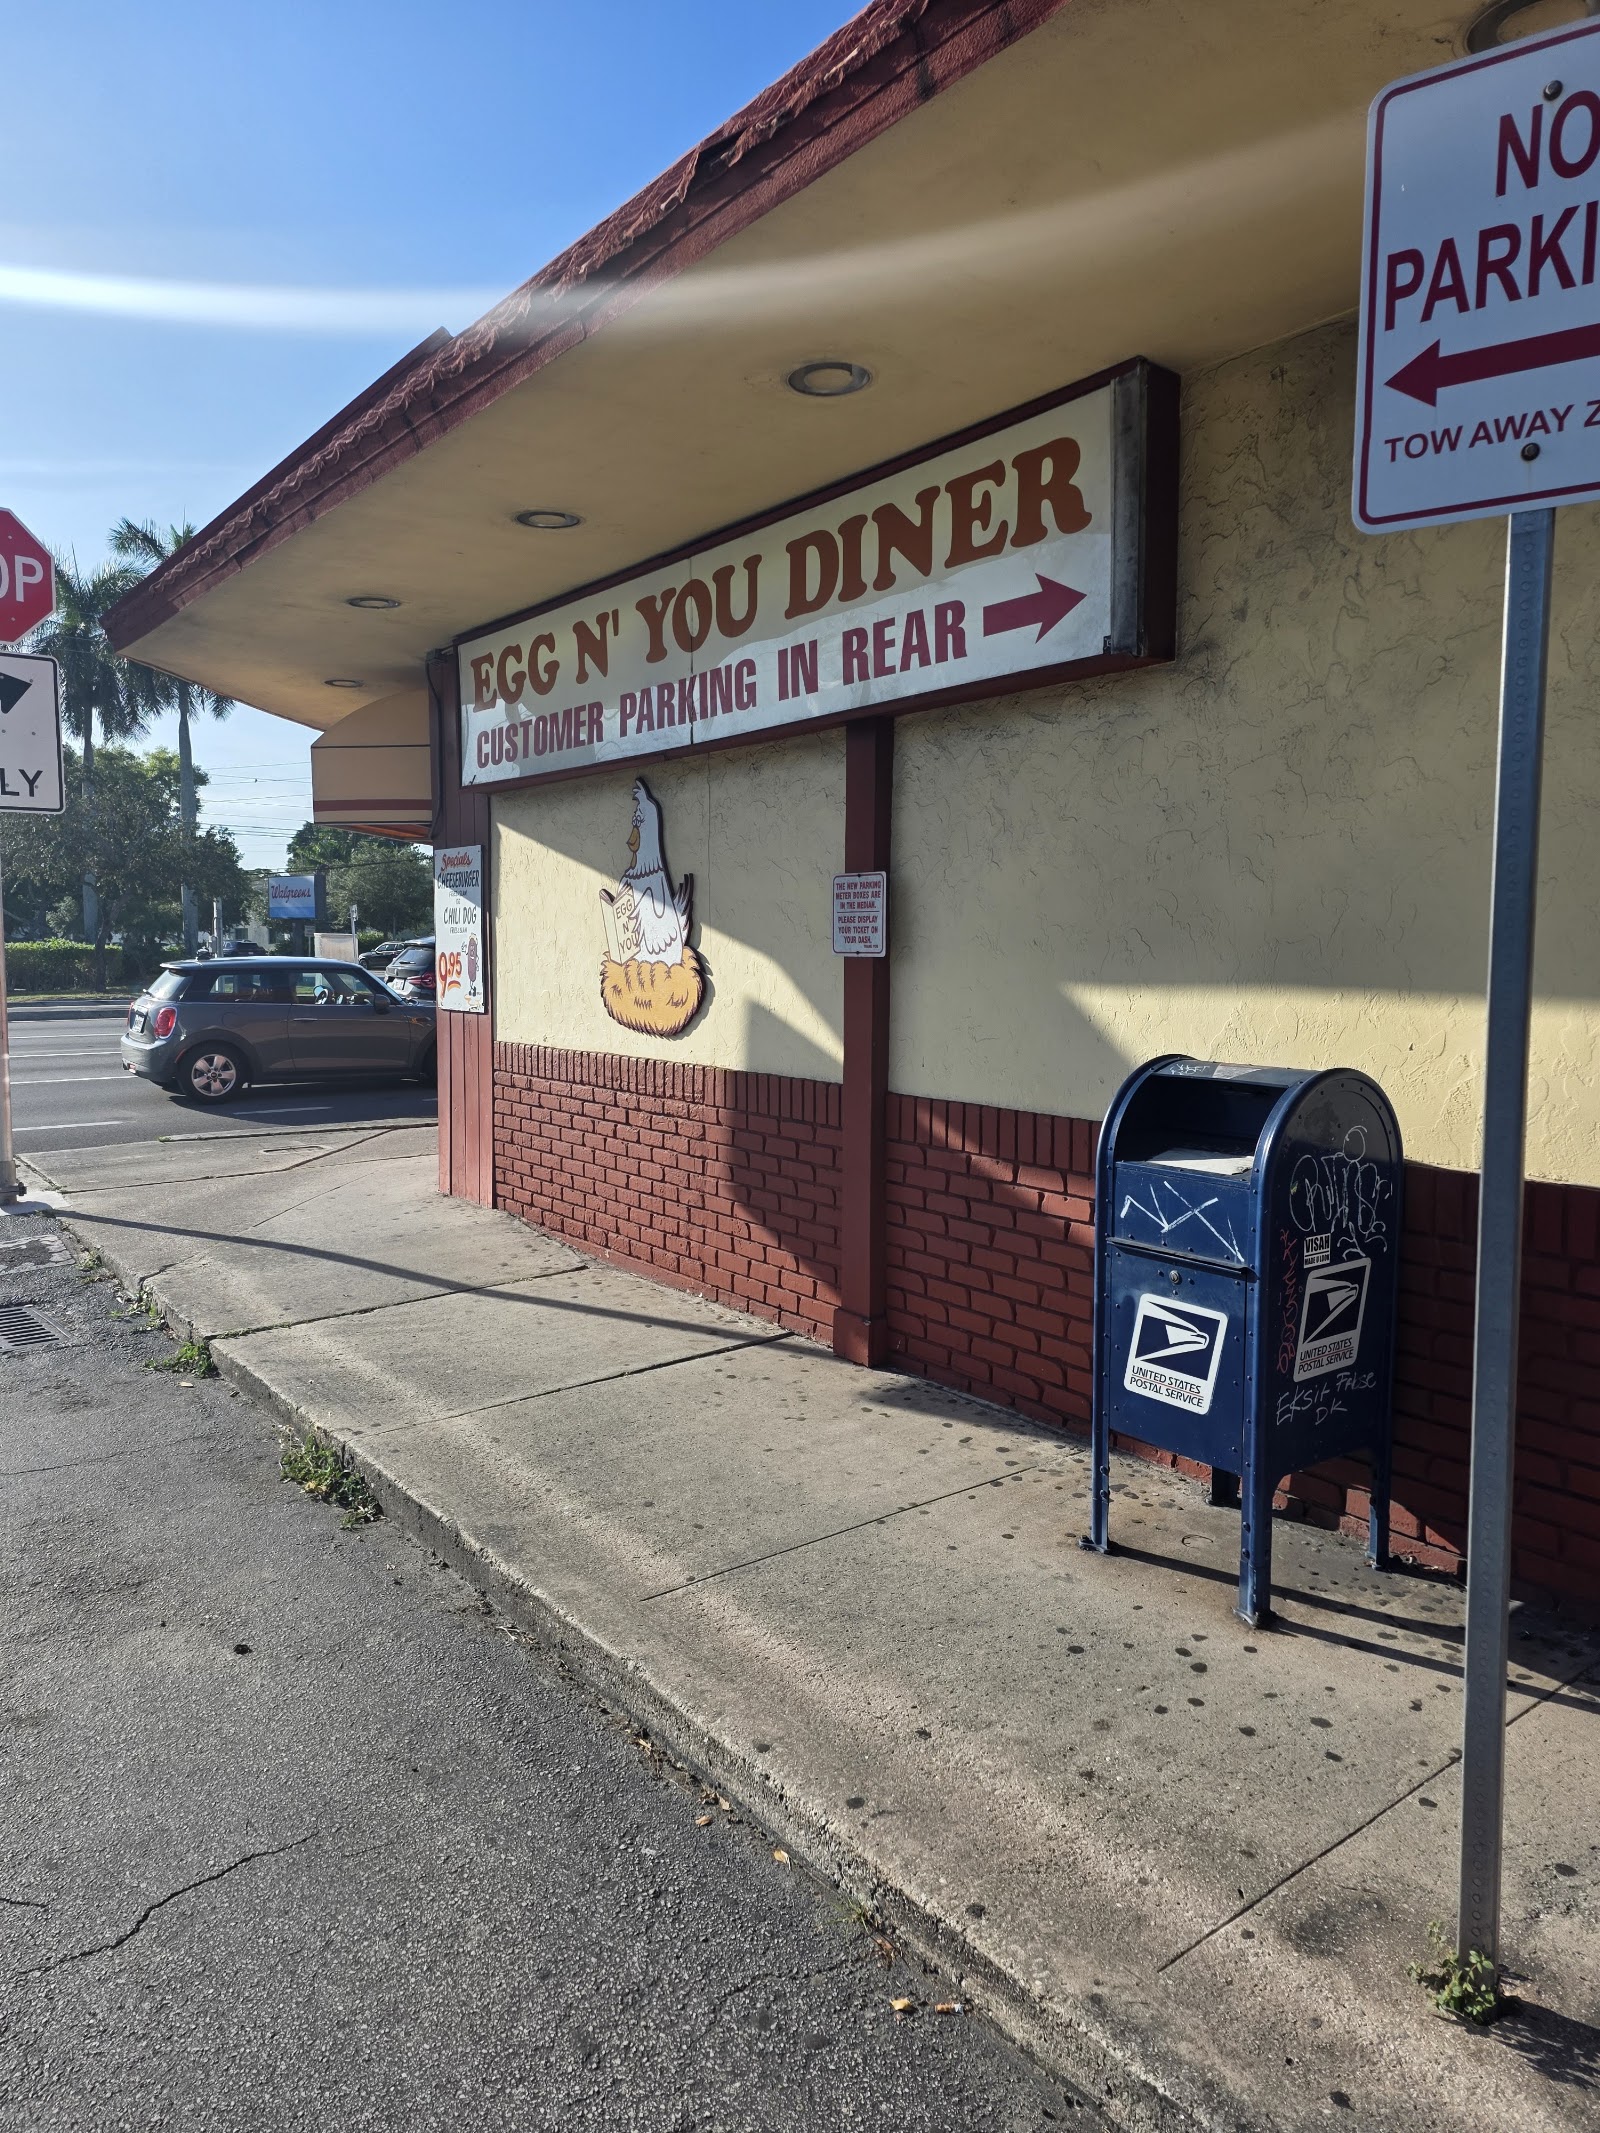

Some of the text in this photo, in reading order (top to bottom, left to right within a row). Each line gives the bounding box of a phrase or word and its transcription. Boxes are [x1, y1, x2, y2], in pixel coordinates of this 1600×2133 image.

[1495, 90, 1600, 198] NO
[1384, 425, 1464, 463] TOW
[1468, 404, 1576, 449] AWAY
[470, 437, 1093, 713] EGG N' YOU DINER
[476, 600, 968, 770] CUSTOMER PARKING IN REAR
[441, 851, 473, 872] Specials
[437, 869, 480, 890] CHEESEBURGER
[836, 881, 882, 891] THE NEW PARKING
[271, 884, 312, 903] Walgreens
[835, 890, 881, 900] METER BOXES ARE
[444, 905, 477, 925] CHILI DOG
[616, 898, 633, 920] EGG
[840, 901, 877, 910] IN THE MEDIAN.
[838, 915, 878, 923] PLEASE DISPLAY
[838, 926, 879, 934] YOUR TICKET ON
[844, 935, 872, 944] YOUR DASH.
[620, 933, 640, 954] YOU
[439, 951, 463, 1001] 9.95
[1305, 1235, 1330, 1254] VISAH
[1299, 1337, 1353, 1361] UNITED STATES
[1298, 1348, 1355, 1375] POSTAL SERVICE
[1132, 1365, 1202, 1395] UNITED STATES
[1130, 1377, 1204, 1408] POSTAL SERVICE
